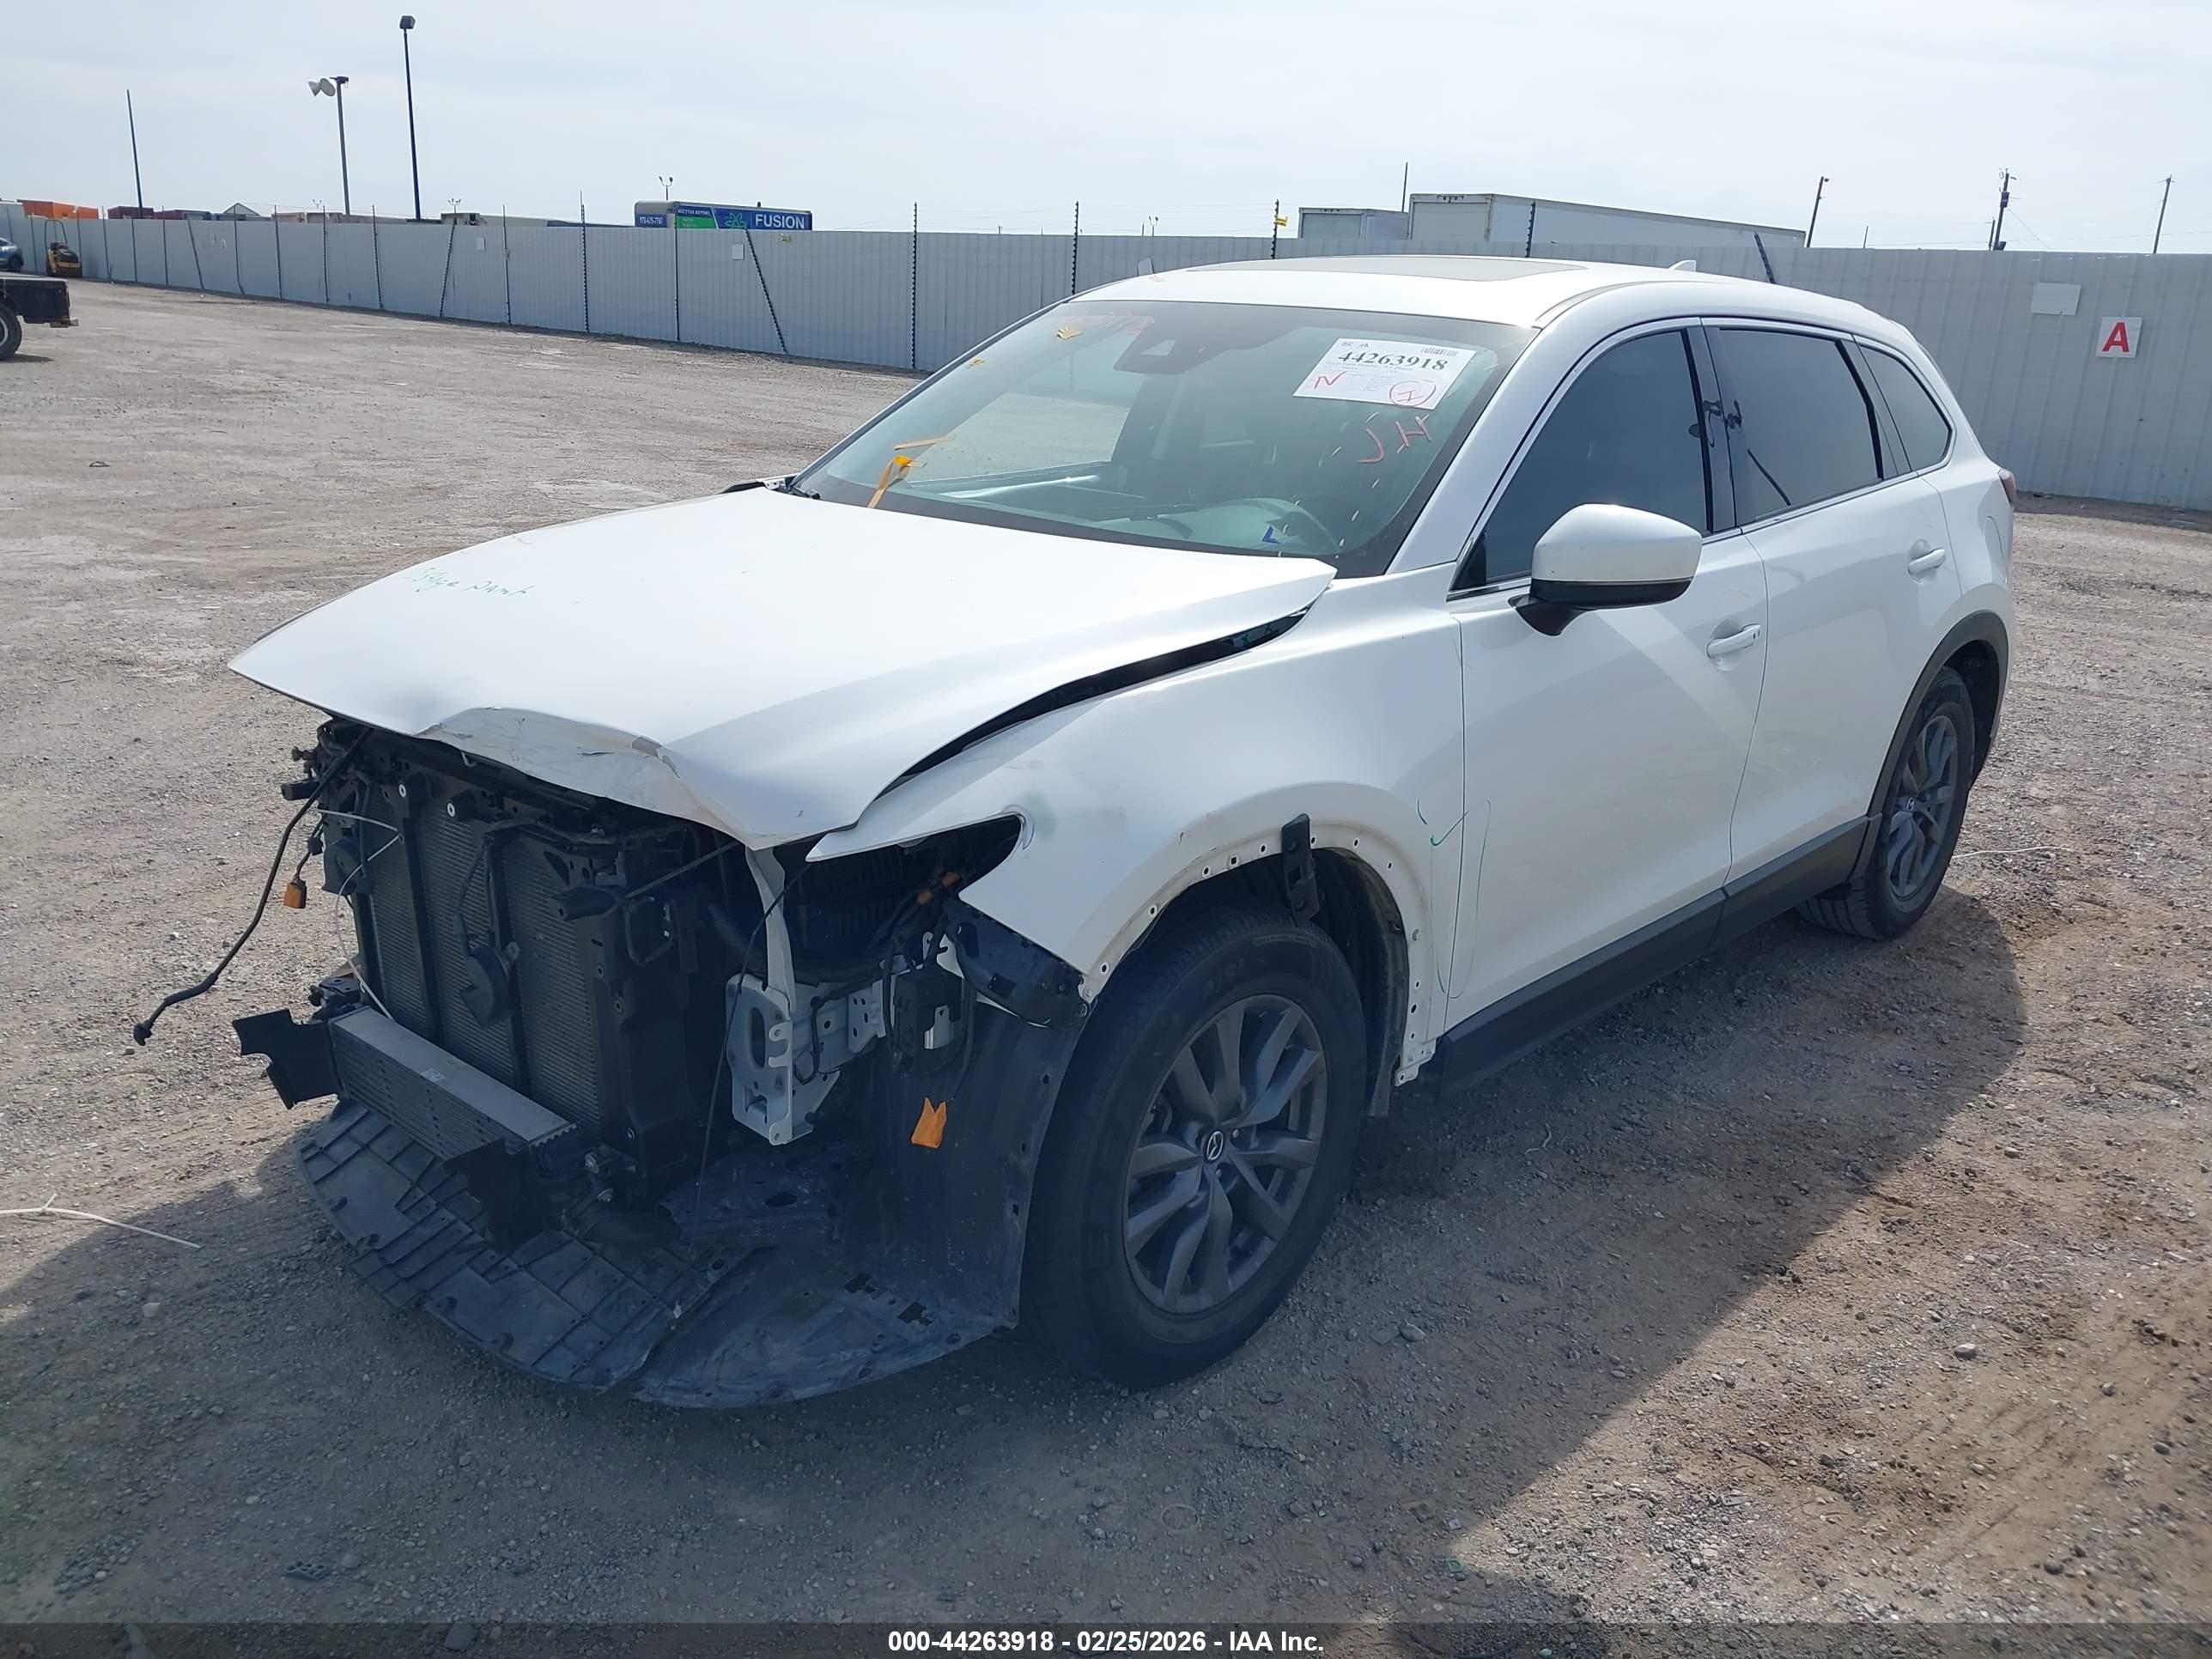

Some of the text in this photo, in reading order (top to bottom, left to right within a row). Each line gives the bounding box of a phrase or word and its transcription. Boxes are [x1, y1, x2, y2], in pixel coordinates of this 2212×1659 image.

[755, 214, 805, 229] FUSION
[2102, 321, 2130, 353] A
[1338, 350, 1449, 372] 44263918
